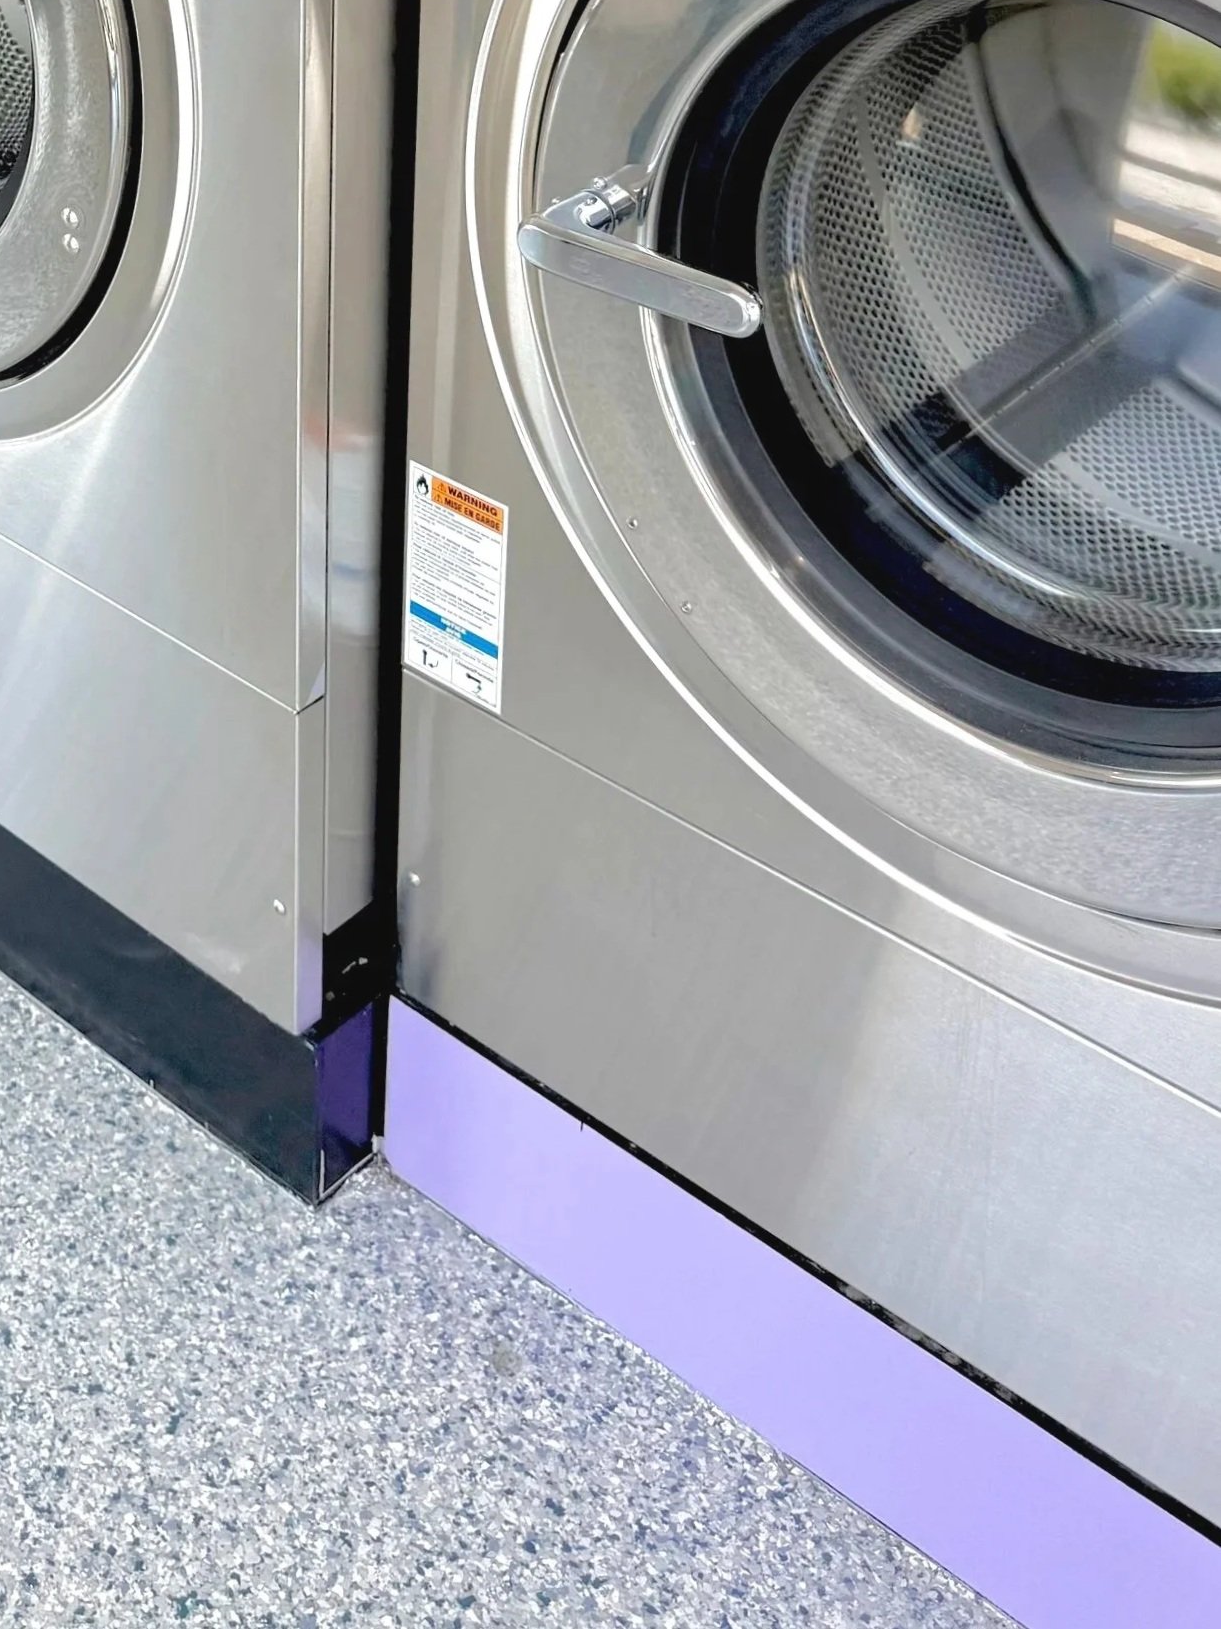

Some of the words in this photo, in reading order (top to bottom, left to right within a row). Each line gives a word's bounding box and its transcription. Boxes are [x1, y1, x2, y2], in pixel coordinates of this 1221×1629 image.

[444, 497, 462, 512] MISE
[464, 507, 474, 518] EN
[475, 512, 500, 532] GARDE
[448, 486, 498, 517] WARNING
